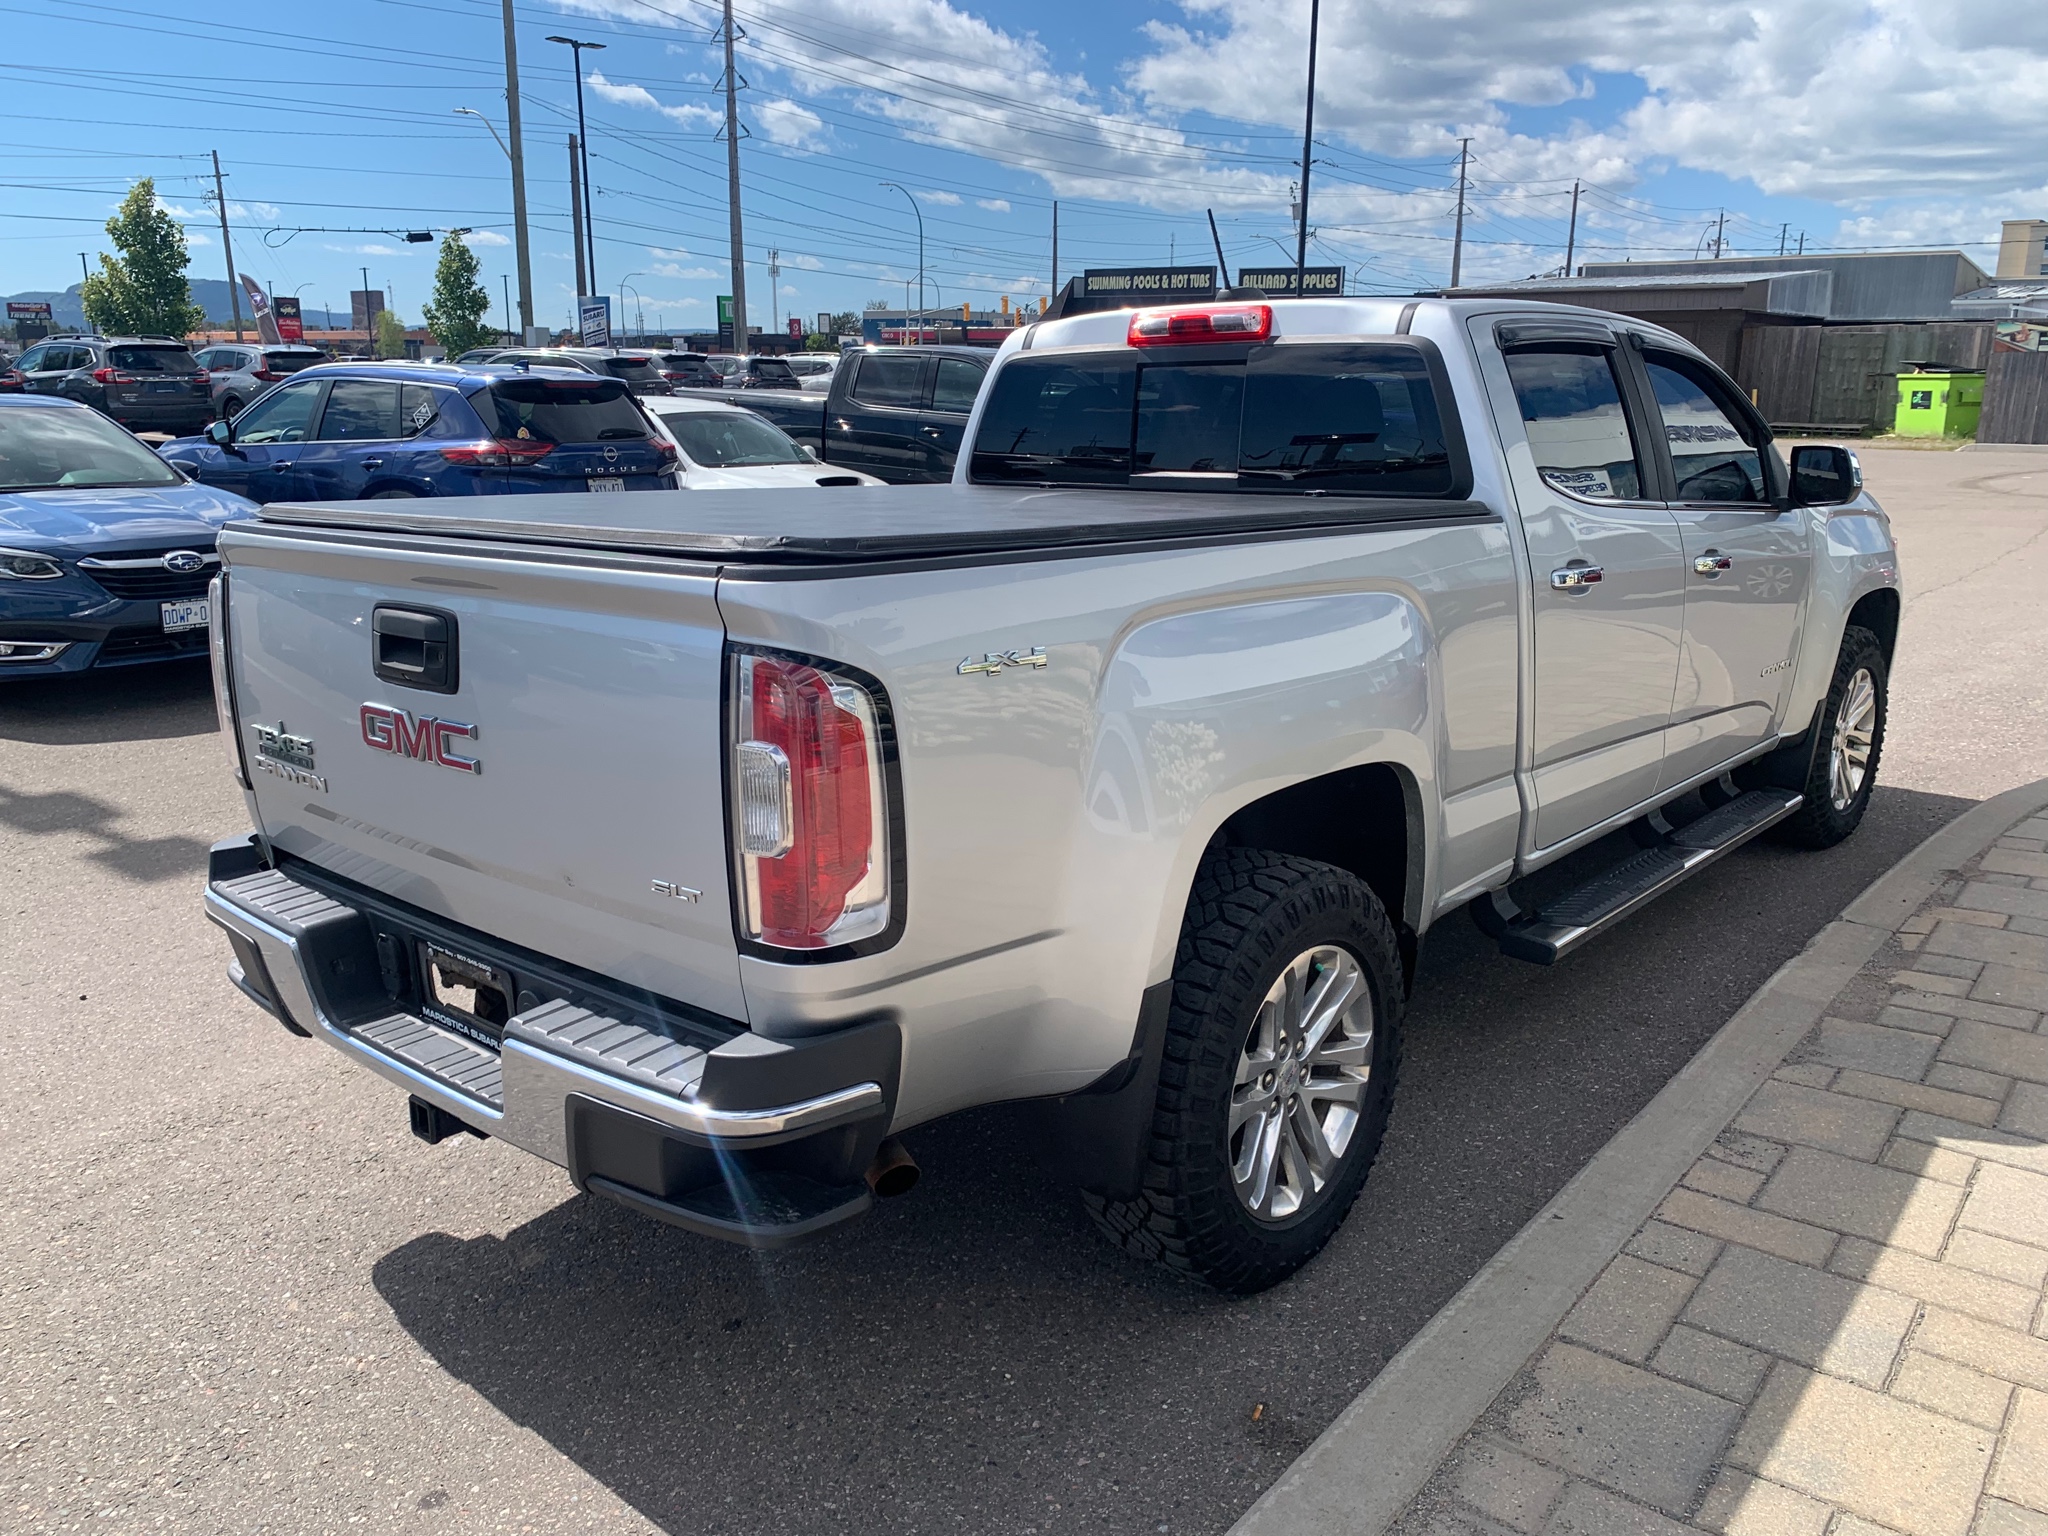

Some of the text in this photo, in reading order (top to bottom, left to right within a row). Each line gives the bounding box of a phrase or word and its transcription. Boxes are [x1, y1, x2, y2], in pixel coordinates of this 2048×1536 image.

[1087, 273, 1210, 290] SWIMMING POOLS & HOT TUBS
[1242, 274, 1338, 289] BILLIARD SPPLIES
[582, 309, 605, 323] SUBARU
[584, 465, 637, 474] ROGUE
[163, 607, 192, 625] DDWP
[360, 701, 481, 775] GMC
[651, 879, 703, 904] SLT
[421, 1006, 470, 1036] MAROSTICA
[470, 1028, 502, 1051] SUBARU
